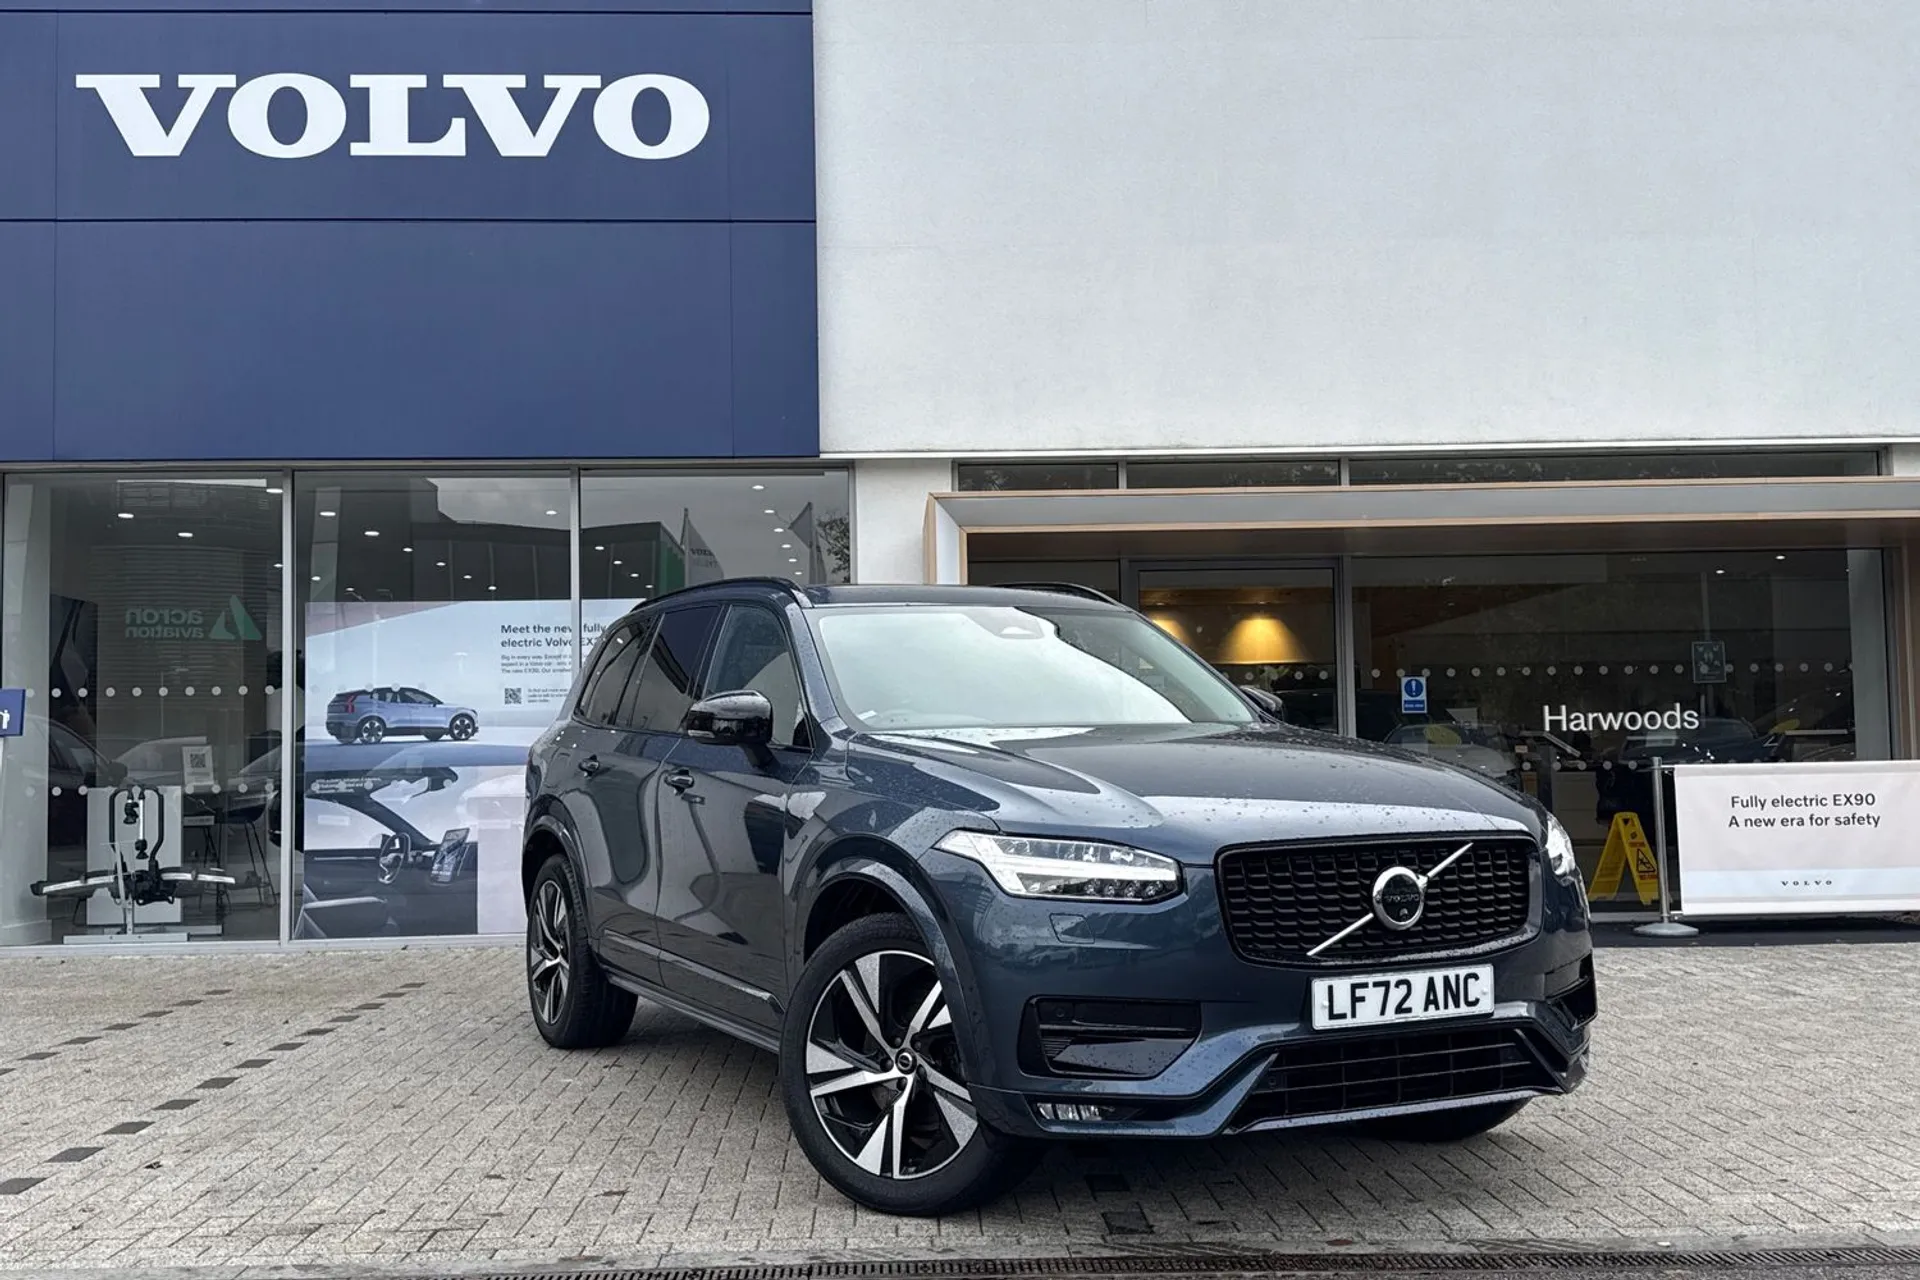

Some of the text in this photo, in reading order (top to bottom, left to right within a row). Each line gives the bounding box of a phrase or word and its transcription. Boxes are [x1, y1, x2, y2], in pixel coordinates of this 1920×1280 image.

[76, 73, 711, 160] VOLVO
[500, 624, 530, 634] Meet
[533, 623, 551, 633] the
[554, 625, 572, 633] ne
[500, 637, 543, 647] electric
[1543, 702, 1699, 731] Harwoods
[1731, 793, 1876, 811] Fully electric EX90
[1728, 813, 1881, 828] A new era for safety
[1327, 972, 1481, 1021] LF72 ANC
